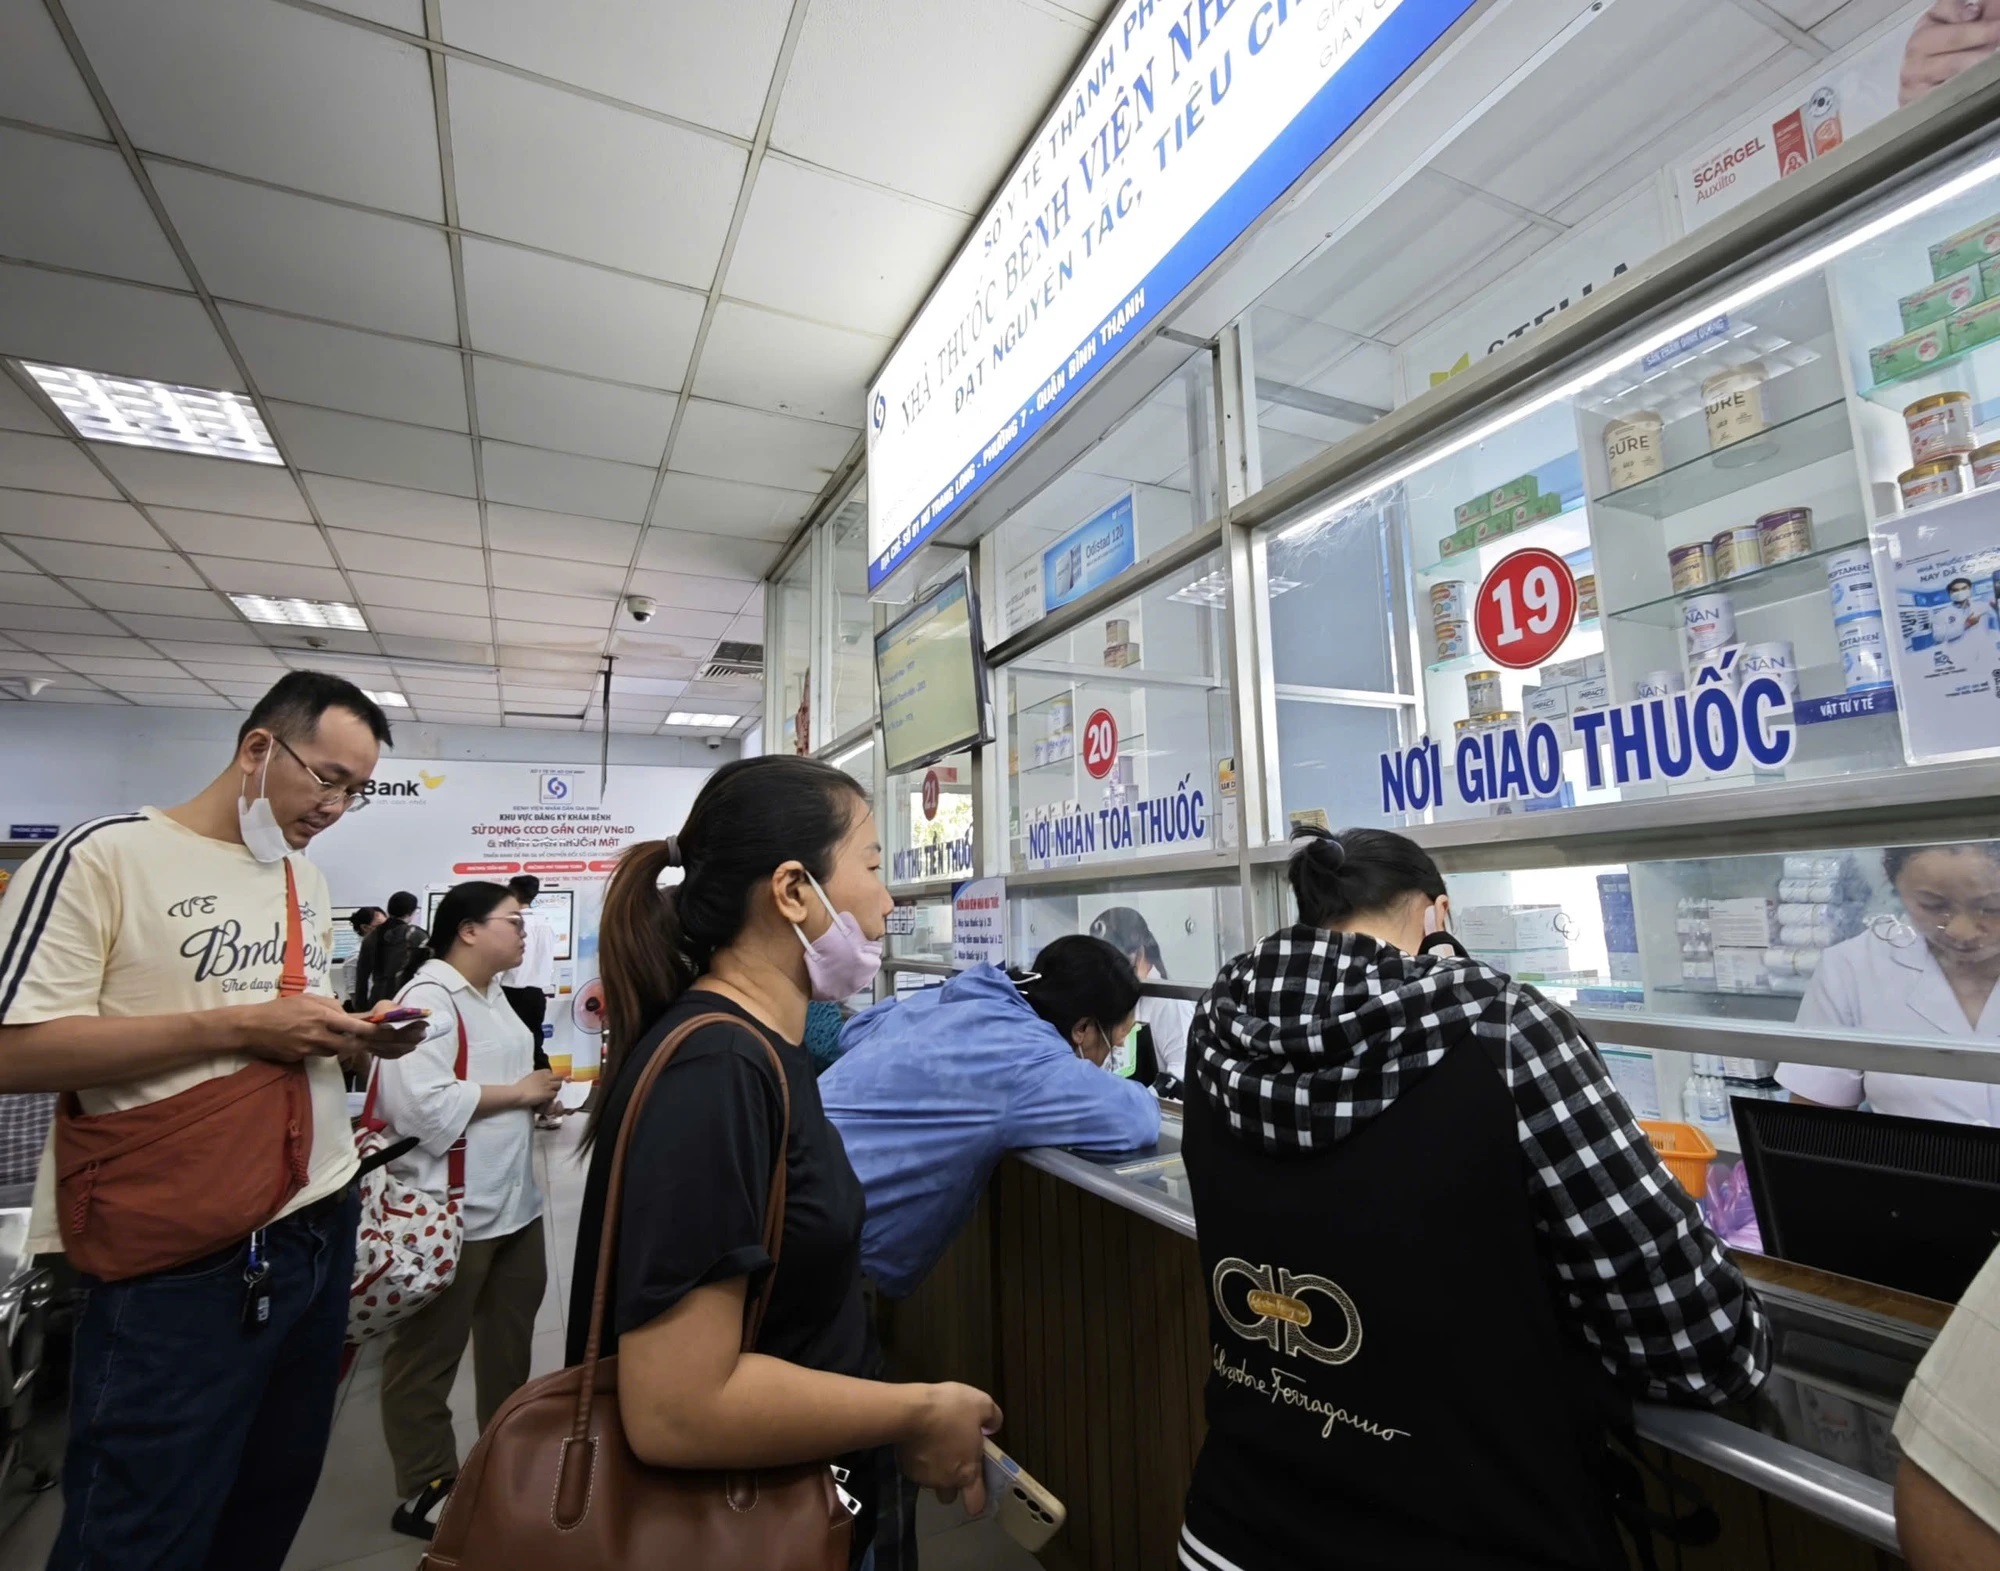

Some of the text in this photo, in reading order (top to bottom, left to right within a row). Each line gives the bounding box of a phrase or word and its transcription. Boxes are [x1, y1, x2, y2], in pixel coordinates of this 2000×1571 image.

[1049, 43, 1114, 159] THÀNH
[1124, 0, 1164, 53] PH
[1693, 136, 1766, 189] SCARGEL
[1019, 408, 1027, 428] 7
[1036, 369, 1065, 411] QUẬN
[1068, 336, 1097, 381] BÌNH
[1100, 287, 1145, 346] THẠNH
[1112, 524, 1125, 543] 120
[1492, 566, 1560, 646] 19
[1684, 608, 1720, 626] NAN
[1743, 656, 1786, 673] NAN
[1088, 720, 1113, 764] 20
[1380, 649, 1792, 813] NƠI GIAO THUỐC
[924, 783, 936, 810] 21
[1029, 772, 1205, 862] NƠI NHẬN TOA THUỐC
[488, 825, 521, 837] DỤNG
[523, 825, 549, 835] CCCD
[946, 823, 974, 873] THUỐ
[222, 978, 248, 993] The
[250, 977, 274, 992] days
[1271, 1367, 1411, 1441] Ferragamo
